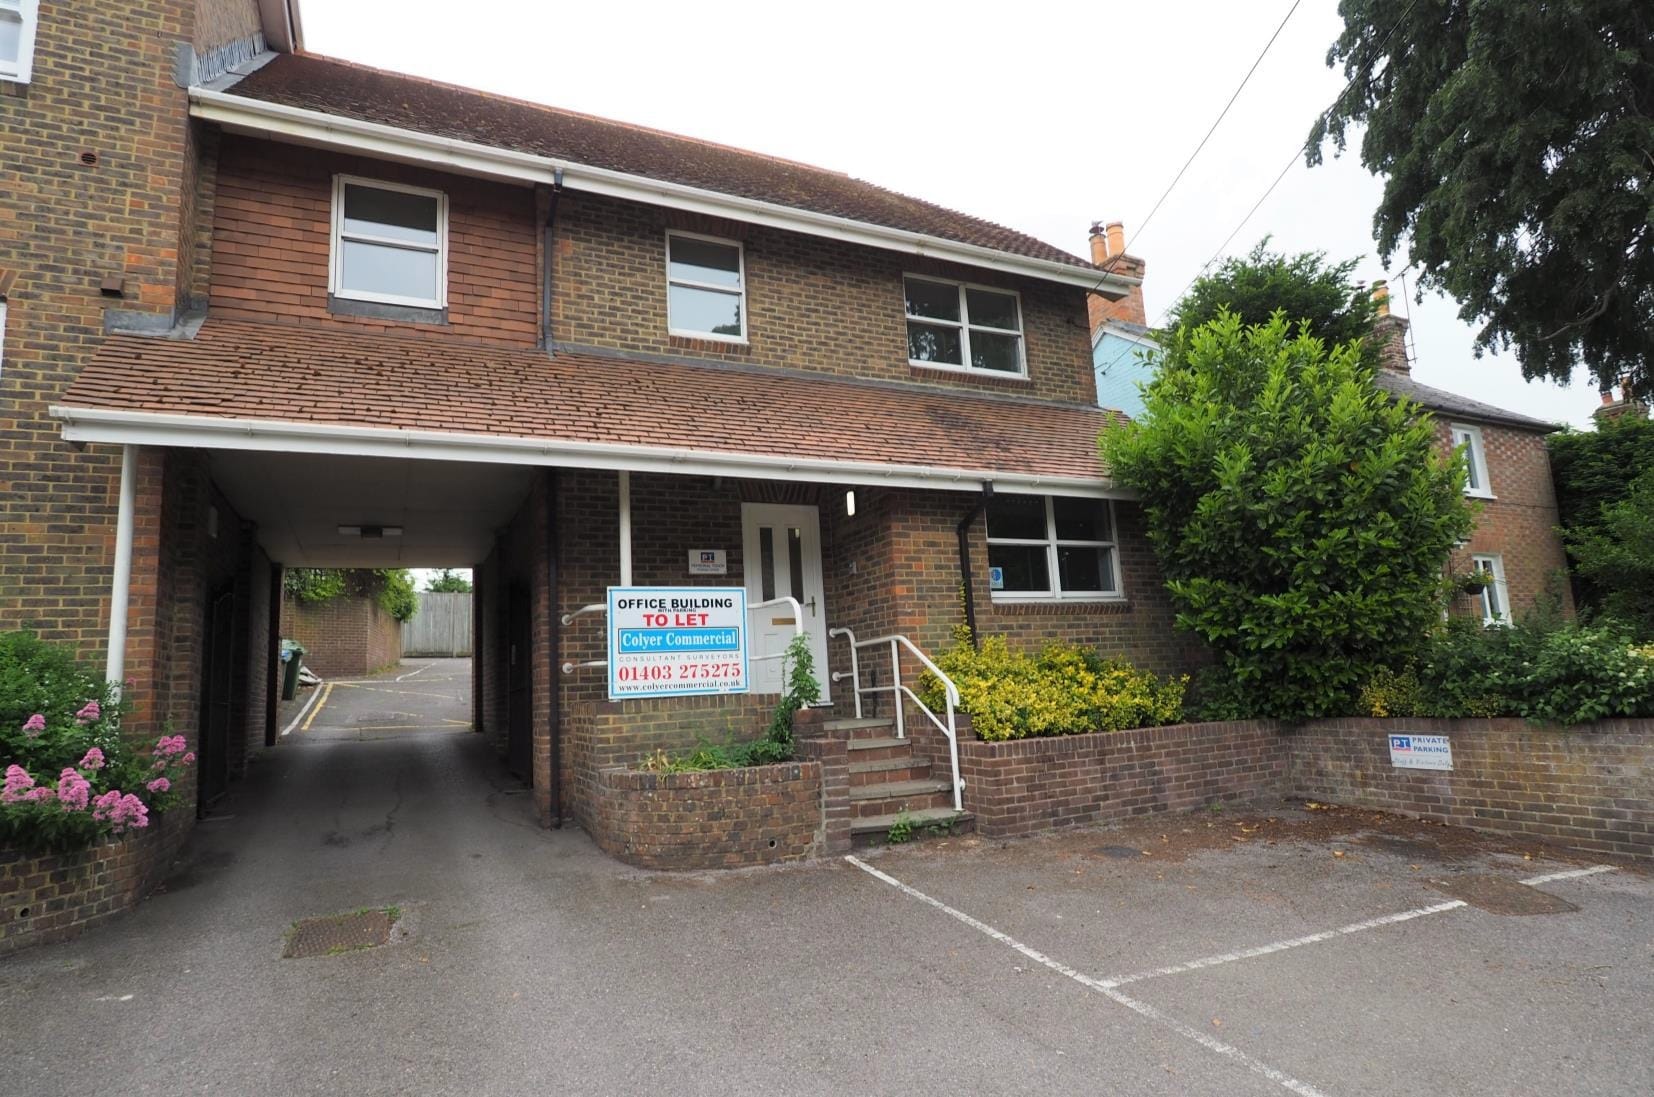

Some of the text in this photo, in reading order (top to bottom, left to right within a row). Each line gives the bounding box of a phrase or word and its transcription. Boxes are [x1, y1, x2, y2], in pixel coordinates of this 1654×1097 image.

[617, 598, 733, 609] OFFICE BUILDING
[643, 613, 709, 627] TO LET
[622, 632, 736, 650] Colyer Commercial
[619, 655, 681, 663] CONSULTANT
[619, 663, 741, 681] 01403 275275
[619, 680, 740, 692] www.colyercommercial.co.uk
[1412, 736, 1448, 744] PRIVATE
